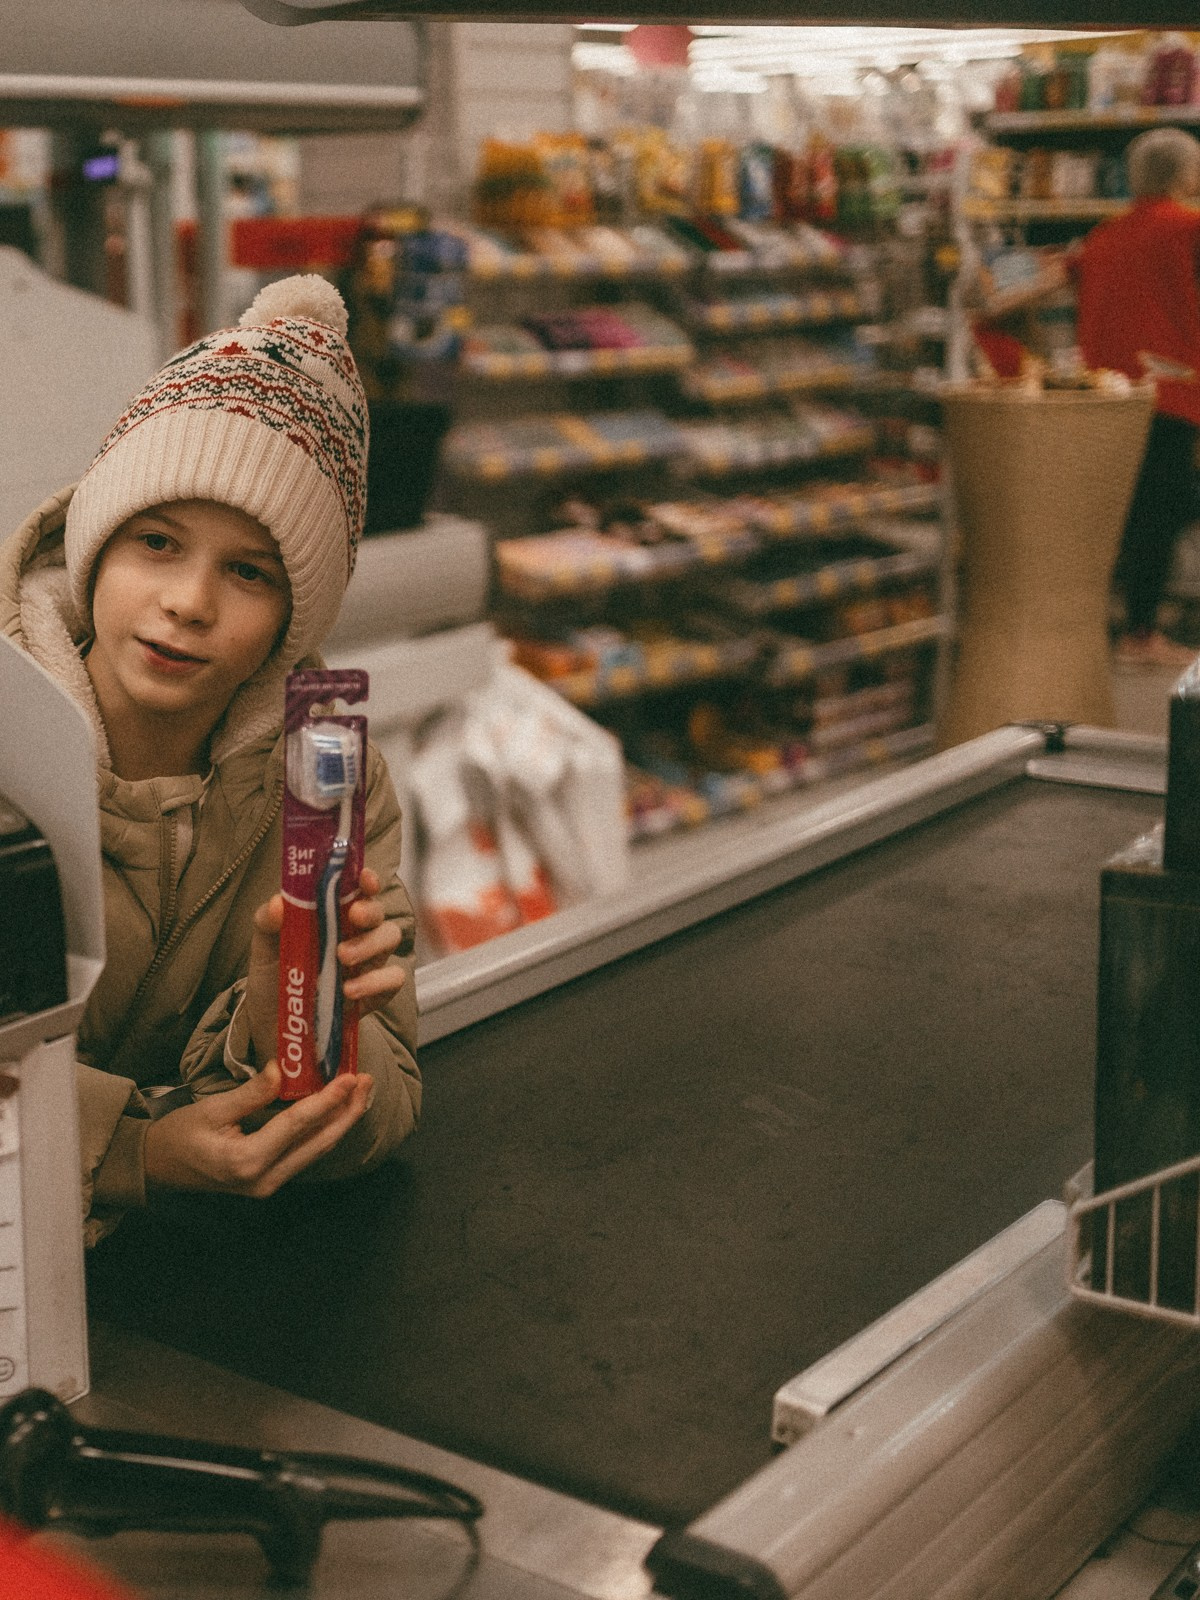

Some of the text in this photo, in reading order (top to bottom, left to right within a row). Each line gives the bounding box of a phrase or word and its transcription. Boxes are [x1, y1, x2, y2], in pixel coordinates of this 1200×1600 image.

[287, 845, 315, 860] Зиг
[288, 861, 314, 876] Заг
[281, 967, 308, 1079] Colgate
